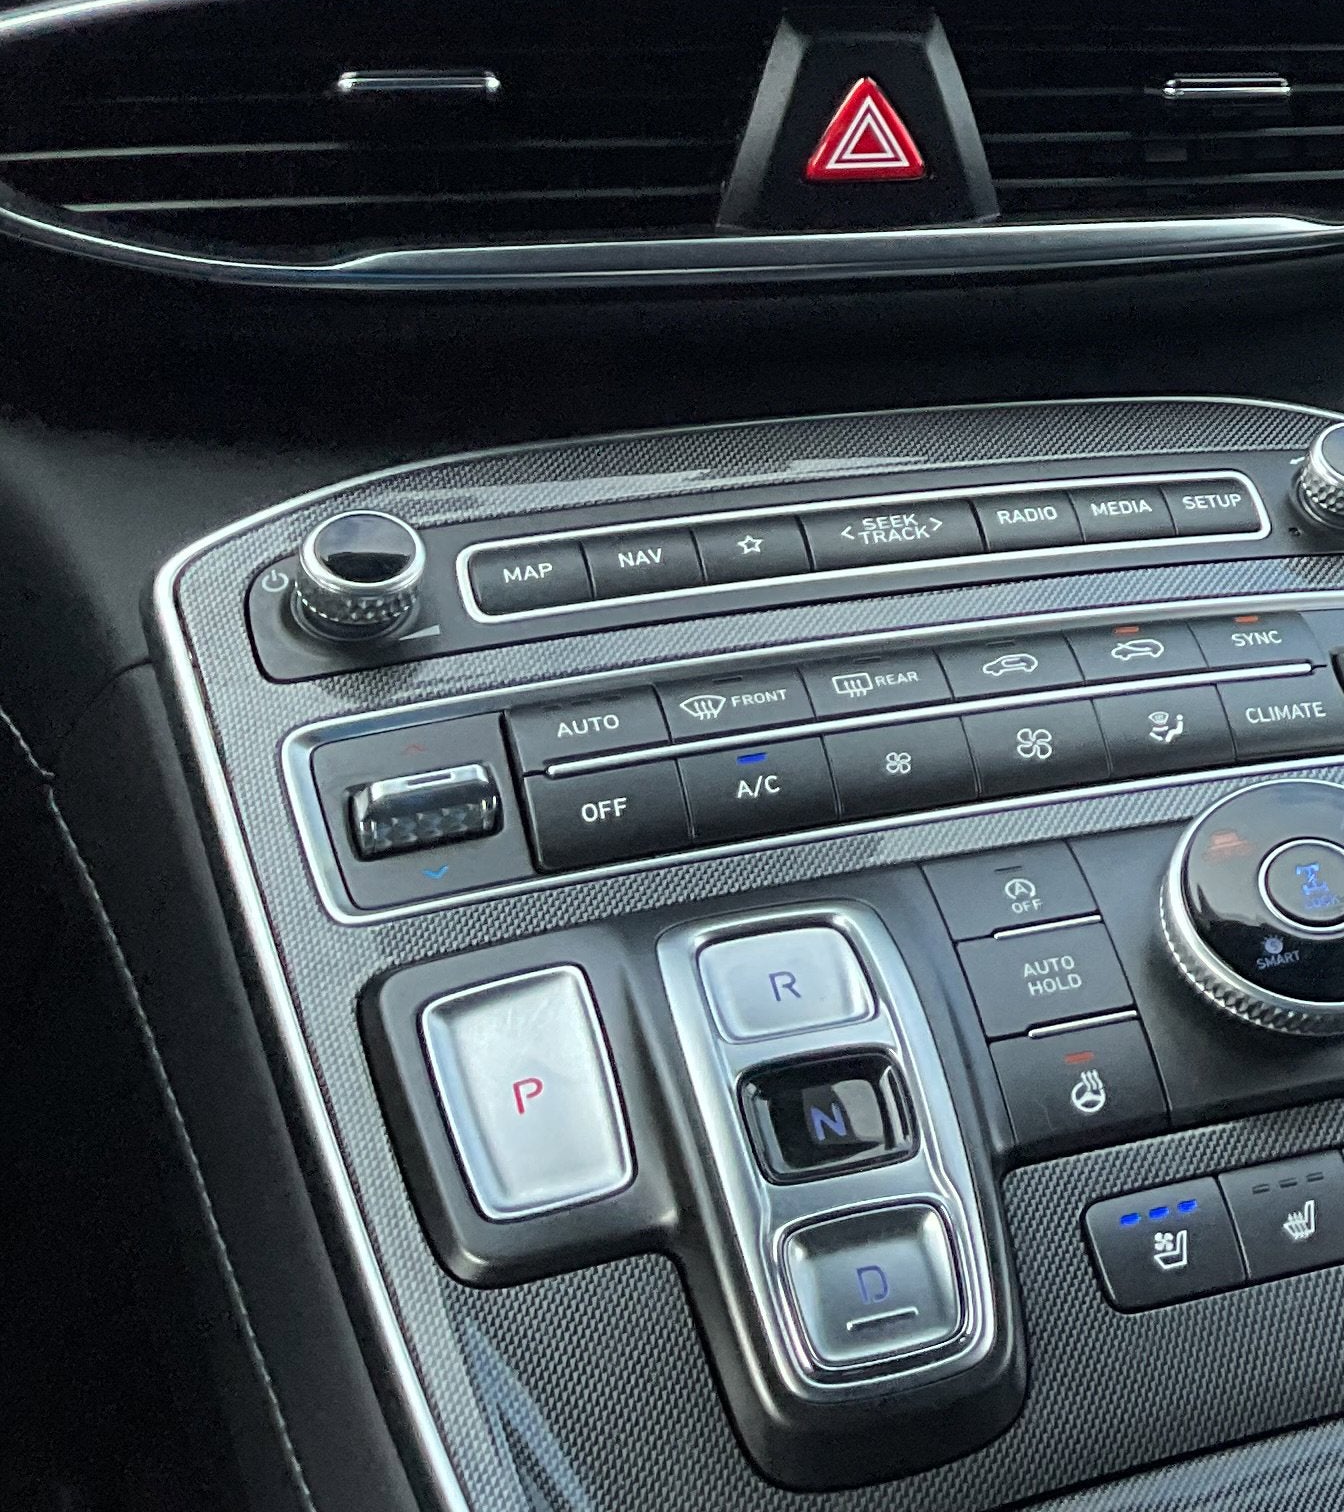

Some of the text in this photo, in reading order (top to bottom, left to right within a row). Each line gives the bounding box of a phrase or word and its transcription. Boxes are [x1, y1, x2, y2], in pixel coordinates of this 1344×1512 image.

[1091, 499, 1153, 515] MEDIA
[1183, 493, 1242, 511] SETUP
[862, 513, 919, 531] SEEK
[997, 506, 1058, 525] RADIO
[858, 524, 930, 545] TRACK
[618, 547, 662, 568] NAV
[503, 562, 553, 583] MAP
[1231, 630, 1283, 647] SYNC
[875, 671, 919, 688] REAR
[731, 688, 787, 708] FRONT
[1245, 701, 1327, 724] CLIMATE
[557, 714, 620, 738] AUTO
[736, 774, 781, 799] A/C
[581, 797, 627, 823] OFF
[1011, 899, 1042, 913] OFF
[1023, 955, 1075, 977] AUTO
[1256, 949, 1301, 970] SMART
[768, 970, 802, 1002] R
[1027, 974, 1082, 995] HOLD
[512, 1077, 545, 1115] P
[810, 1102, 848, 1142] N
[856, 1264, 890, 1305] D
